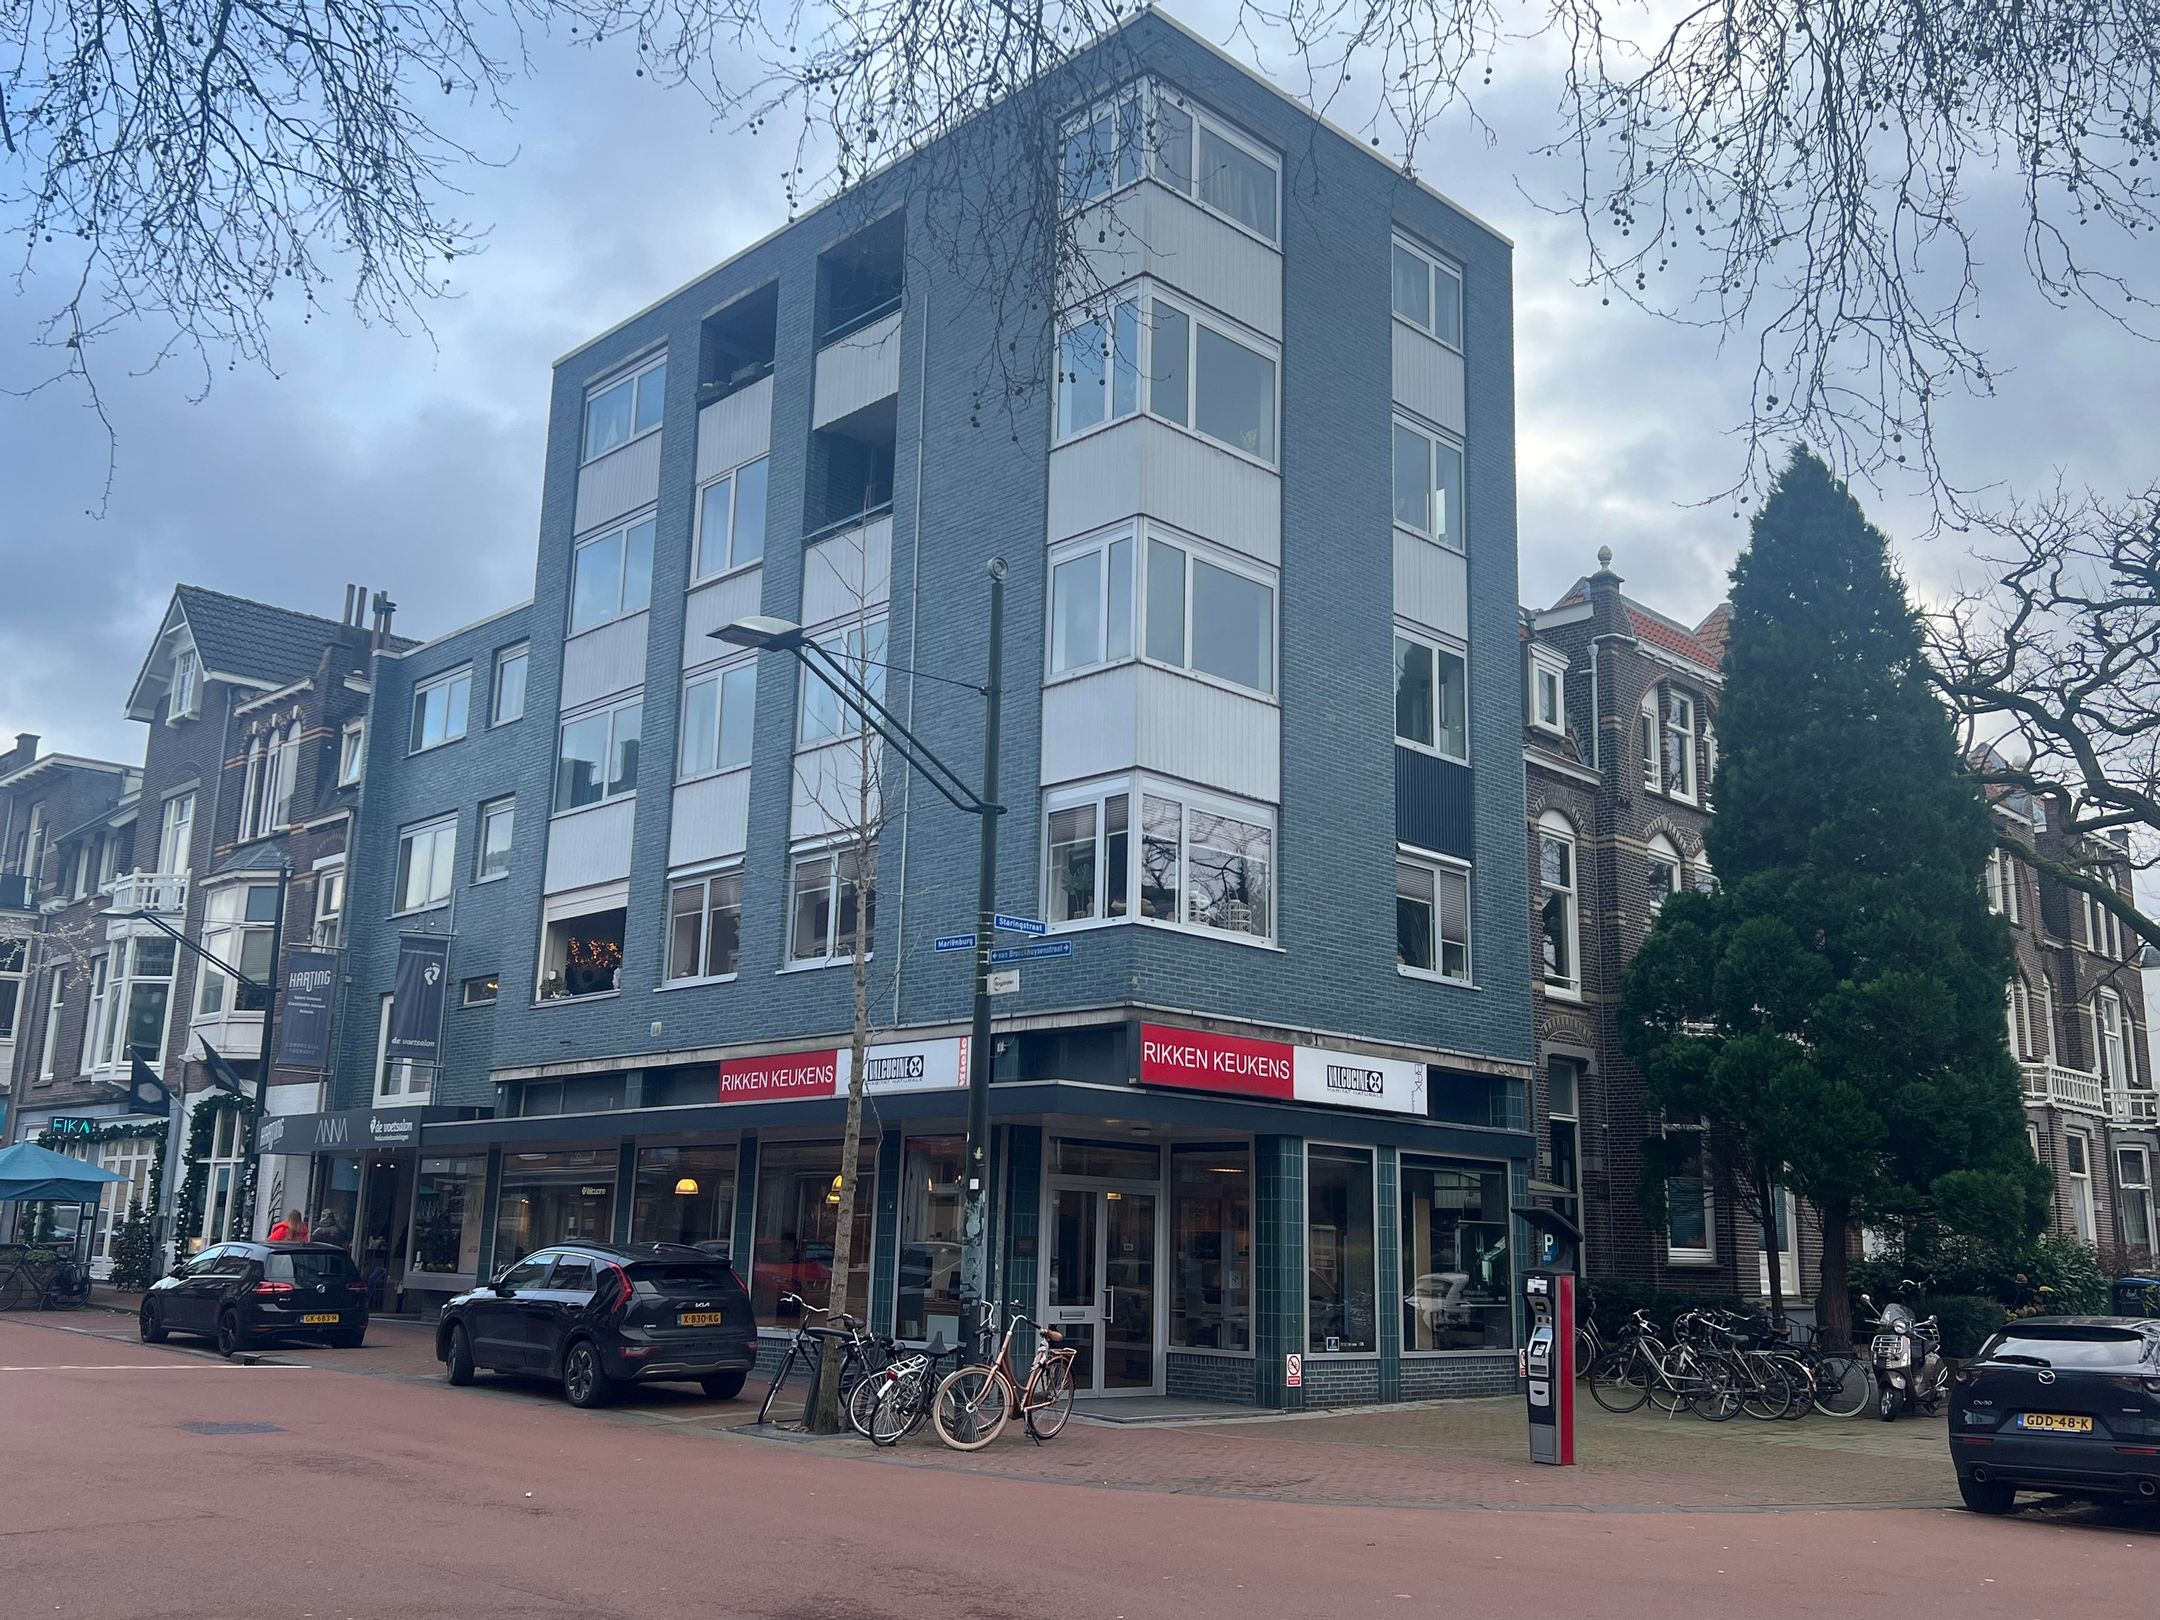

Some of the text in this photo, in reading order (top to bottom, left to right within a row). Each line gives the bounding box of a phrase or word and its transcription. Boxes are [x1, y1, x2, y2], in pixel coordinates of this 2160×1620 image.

[999, 917, 1043, 932] Staringstraat
[938, 938, 973, 948] Mariënburg
[289, 970, 331, 992] HARTING
[391, 1037, 435, 1047] de voetsalon
[869, 1057, 910, 1080] VALCUCINE
[959, 1038, 968, 1086] Miele
[1144, 1041, 1290, 1080] RIKKEN KEUKENS
[721, 1065, 834, 1091] RIKKEN KEUKENS
[1328, 1066, 1370, 1091] VALCUCINE
[53, 1118, 90, 1134] FIKA
[374, 1118, 413, 1133] de voetsalon
[1544, 1233, 1554, 1253] P
[683, 1313, 719, 1324] X-830-KG
[2026, 1414, 2089, 1429] GDD-48-K
